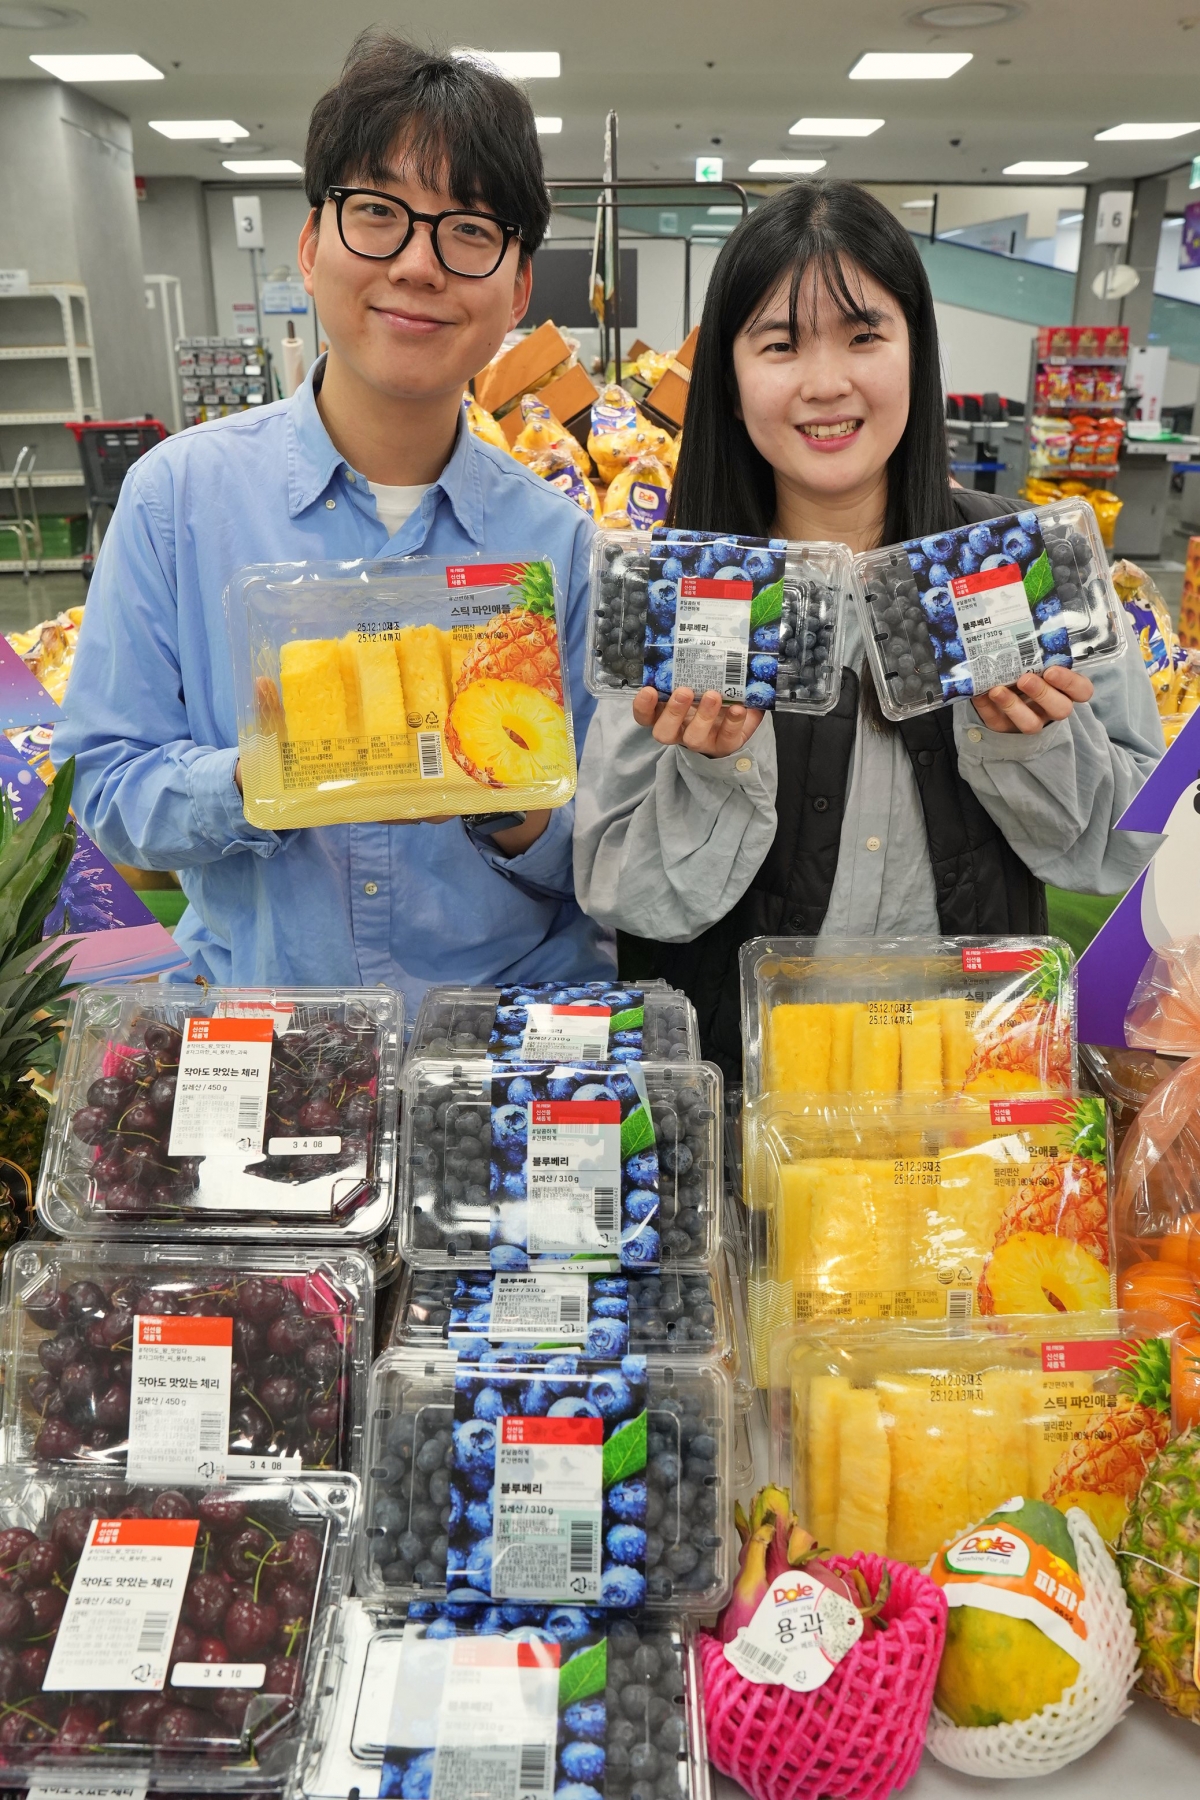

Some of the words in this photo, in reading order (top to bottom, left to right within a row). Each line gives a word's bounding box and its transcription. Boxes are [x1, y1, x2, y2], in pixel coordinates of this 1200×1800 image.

[1112, 211, 1122, 228] 6
[243, 217, 254, 233] 3
[638, 491, 655, 501] Dole
[450, 606, 470, 617] 스틱
[472, 604, 511, 616] 파인애플
[679, 623, 709, 632] 블루베리
[962, 616, 992, 631] 블루베리
[965, 635, 983, 644] 칠레산
[964, 991, 985, 1004] 스틱
[184, 1067, 211, 1077] 작아도
[212, 1067, 240, 1078] 맛있는
[241, 1068, 260, 1078] 체리
[994, 1115, 1012, 1123] 새롭게
[313, 1140, 323, 1148] 08
[532, 1156, 569, 1167] 블루베리
[993, 1168, 1020, 1177] 필리핀산
[531, 1175, 553, 1183] 칠레산
[558, 1175, 574, 1183] 310
[993, 1178, 1016, 1187] 파인애플
[143, 1326, 162, 1334] 신선을
[142, 1334, 162, 1342] 새롭게
[1046, 1353, 1065, 1361] 신선을
[1046, 1361, 1066, 1369] 새롭게
[137, 1376, 167, 1388] 작아도
[169, 1377, 199, 1389] 맛있는
[200, 1378, 220, 1389] 체리
[1042, 1381, 1075, 1389] #간편하게
[136, 1396, 159, 1405] 칠레산
[164, 1397, 181, 1406] 450
[1043, 1398, 1067, 1409] 스틱
[1070, 1394, 1118, 1409] 파인애플
[1043, 1421, 1073, 1432] 필리핀산
[1043, 1432, 1069, 1442] 파인애플
[1070, 1431, 1089, 1441] 100%
[250, 1460, 255, 1469] 3
[260, 1460, 266, 1469] 4
[271, 1461, 282, 1470] 08
[500, 1457, 529, 1465] #간편하게
[500, 1482, 542, 1494] 블루베리
[499, 1504, 523, 1514] 칠레산
[530, 1505, 546, 1514] 310
[960, 1536, 1016, 1554] Dole
[955, 1555, 985, 1564] Sunshine
[985, 1555, 998, 1564] For
[999, 1557, 1010, 1566] All
[80, 1577, 113, 1588] 작아도
[115, 1577, 149, 1589] 맛있는
[151, 1578, 174, 1589] 체리
[773, 1583, 814, 1604] Dole
[74, 1597, 100, 1605] 칠레산
[106, 1597, 124, 1605] 450
[775, 1612, 824, 1644] 용과
[204, 1668, 210, 1678] 3
[217, 1668, 223, 1678] 4
[230, 1668, 242, 1678] 10
